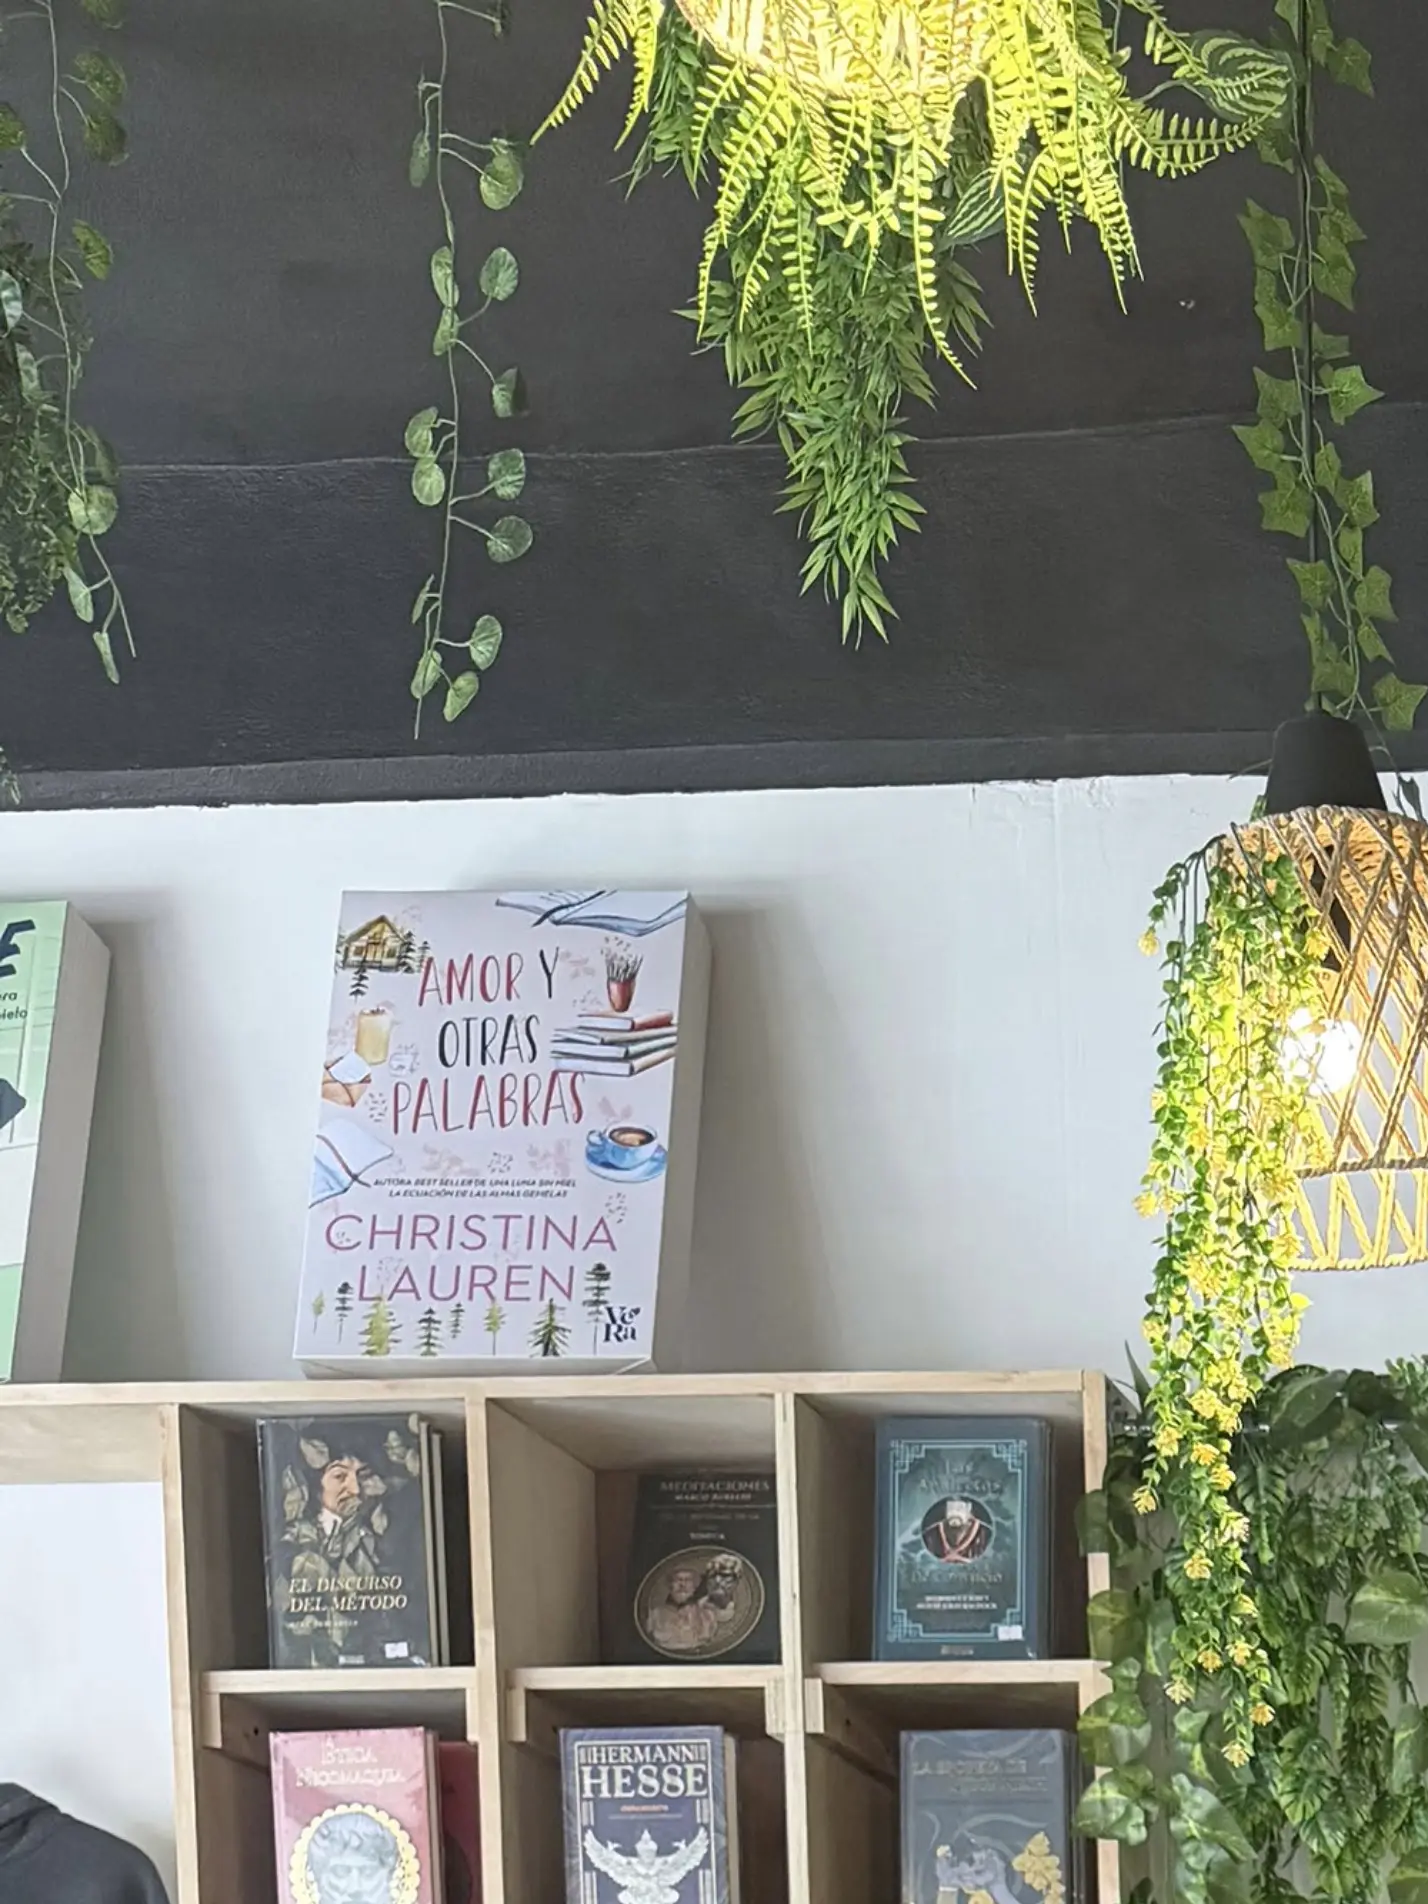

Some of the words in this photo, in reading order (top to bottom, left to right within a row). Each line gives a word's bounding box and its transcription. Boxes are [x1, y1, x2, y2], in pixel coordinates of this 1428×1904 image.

[417, 953, 522, 1007] AMOR
[538, 946, 561, 999] Y
[438, 1014, 540, 1069] OTRAS
[391, 1071, 586, 1135] PALABRAS
[325, 1214, 619, 1253] CHRISTINA
[357, 1264, 575, 1302] LAUREN
[288, 1577, 312, 1594] EL
[316, 1575, 403, 1594] DISCURSO
[289, 1597, 328, 1613] DEL
[332, 1591, 409, 1613] MÉTODO
[592, 1745, 694, 1765] HERMANN
[581, 1764, 708, 1799] HESSE
